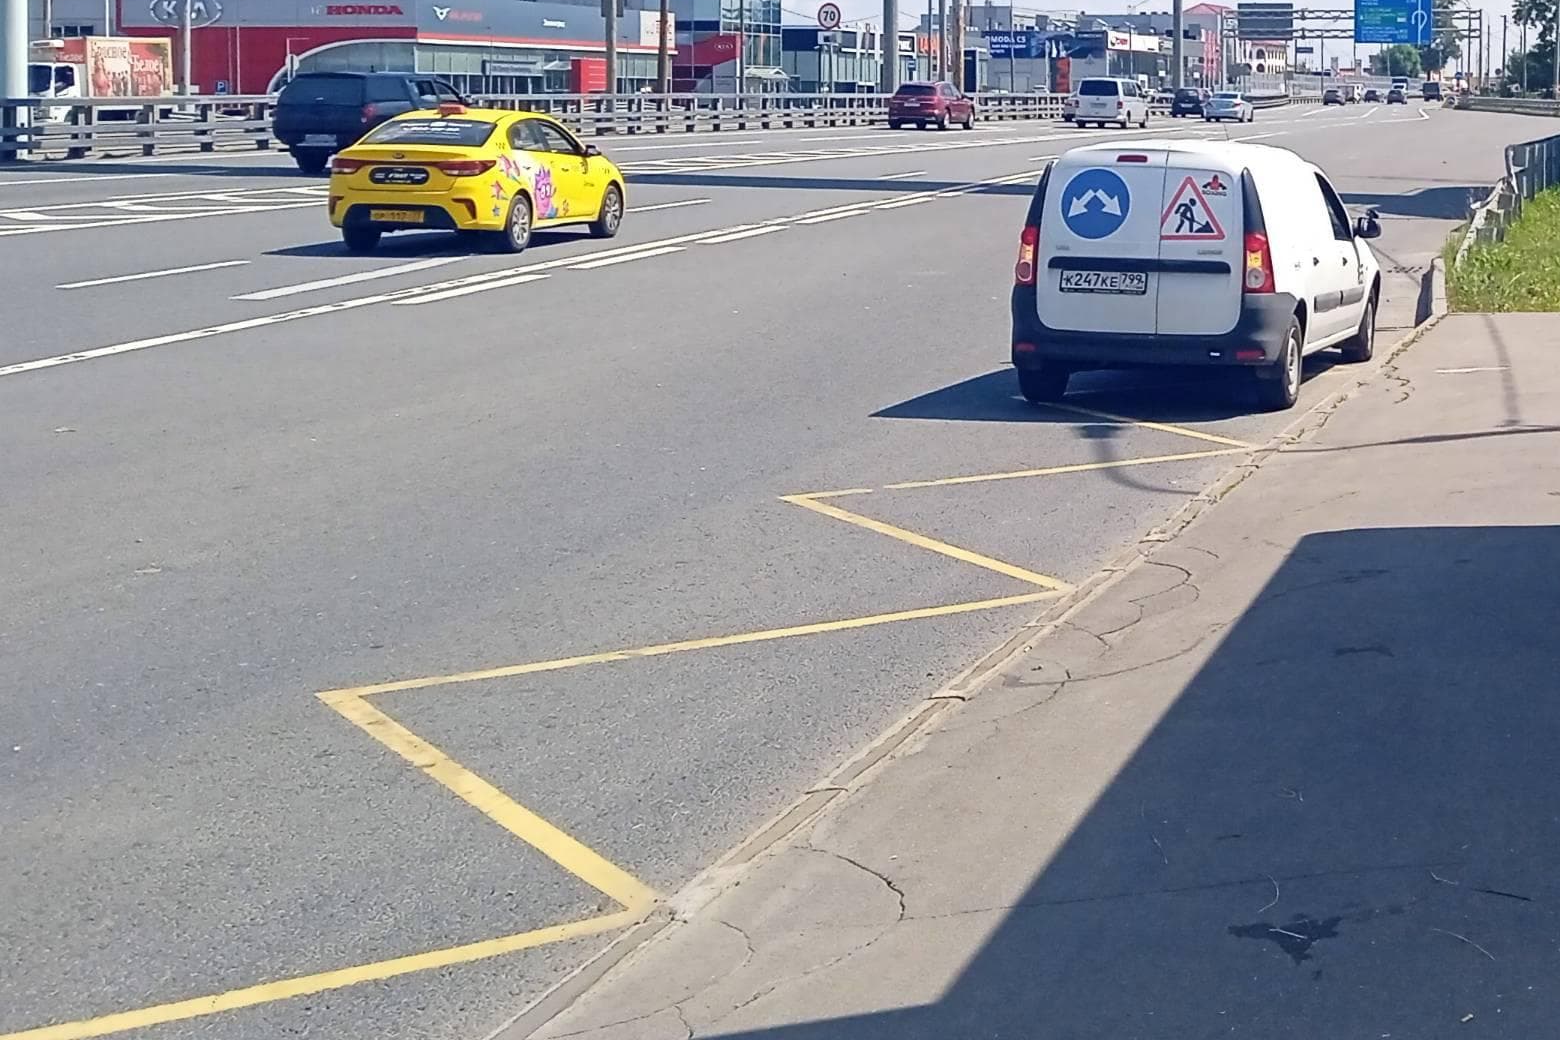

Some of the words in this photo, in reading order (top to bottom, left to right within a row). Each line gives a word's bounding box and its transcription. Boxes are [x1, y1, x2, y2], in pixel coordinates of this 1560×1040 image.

[162, 0, 208, 19] KA
[326, 5, 404, 15] HONDA
[822, 10, 836, 22] 70
[1121, 273, 1143, 285] 799
